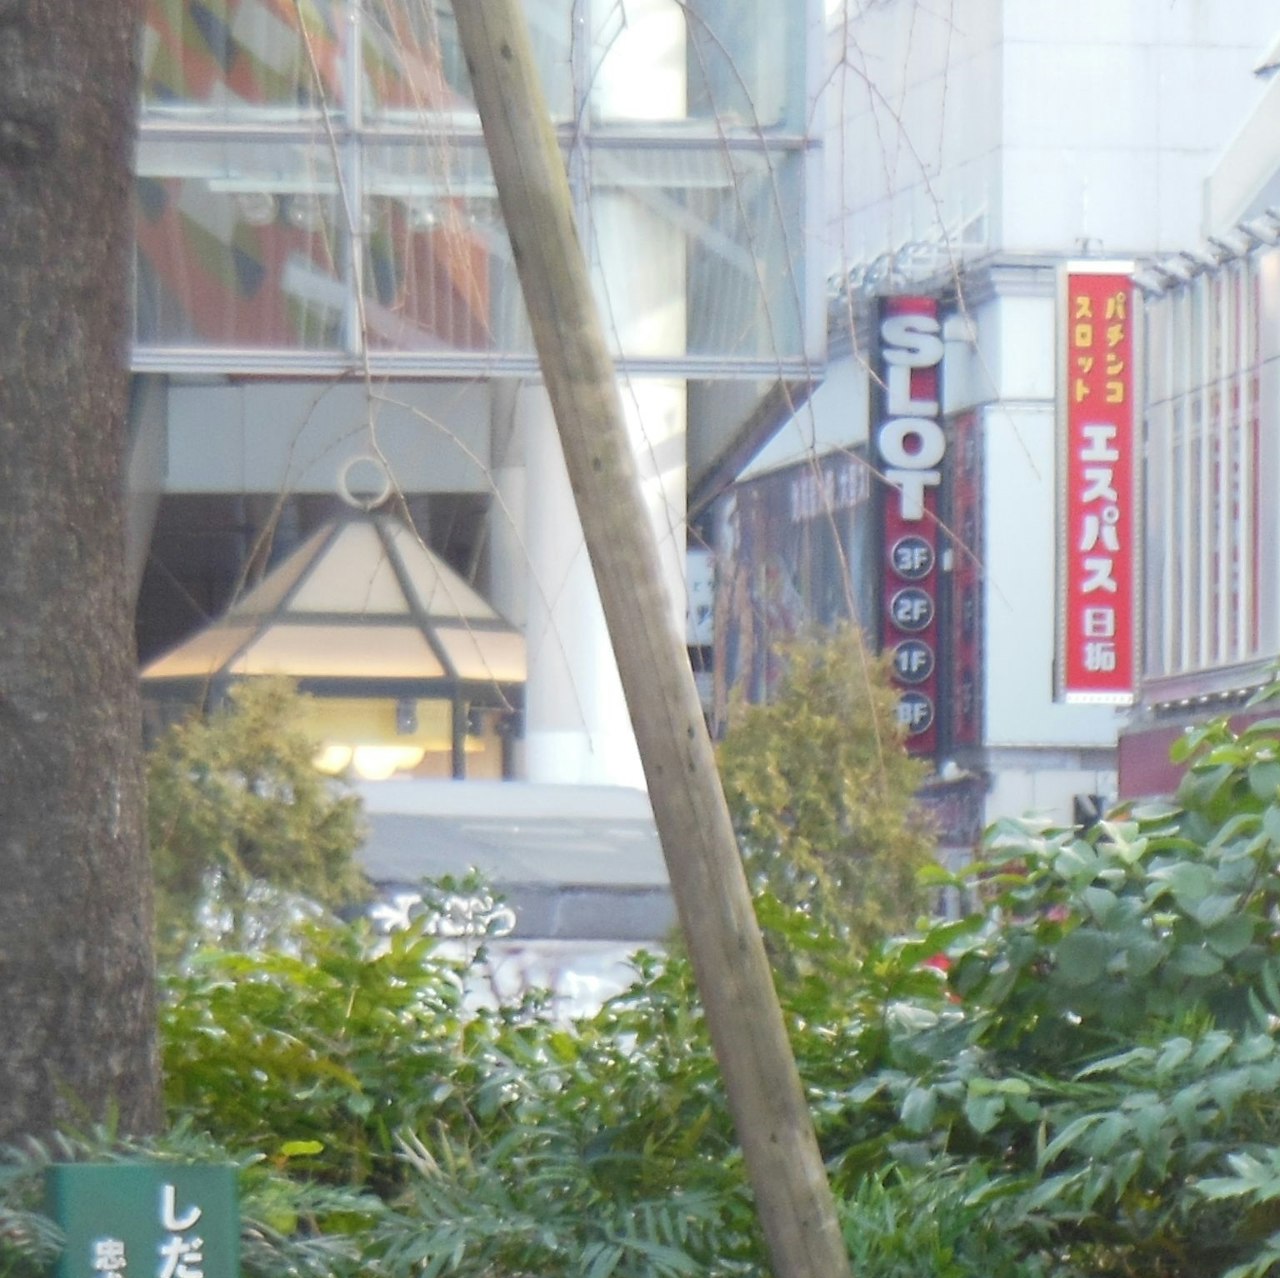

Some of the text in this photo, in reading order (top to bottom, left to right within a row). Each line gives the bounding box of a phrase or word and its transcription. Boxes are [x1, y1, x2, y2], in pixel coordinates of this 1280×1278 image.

[1075, 296, 1093, 403] スロット
[1105, 292, 1127, 403] パチンコ
[879, 314, 946, 520] SLOT
[897, 548, 927, 570] 3F
[897, 600, 927, 621] 2F
[898, 651, 926, 673] 1F
